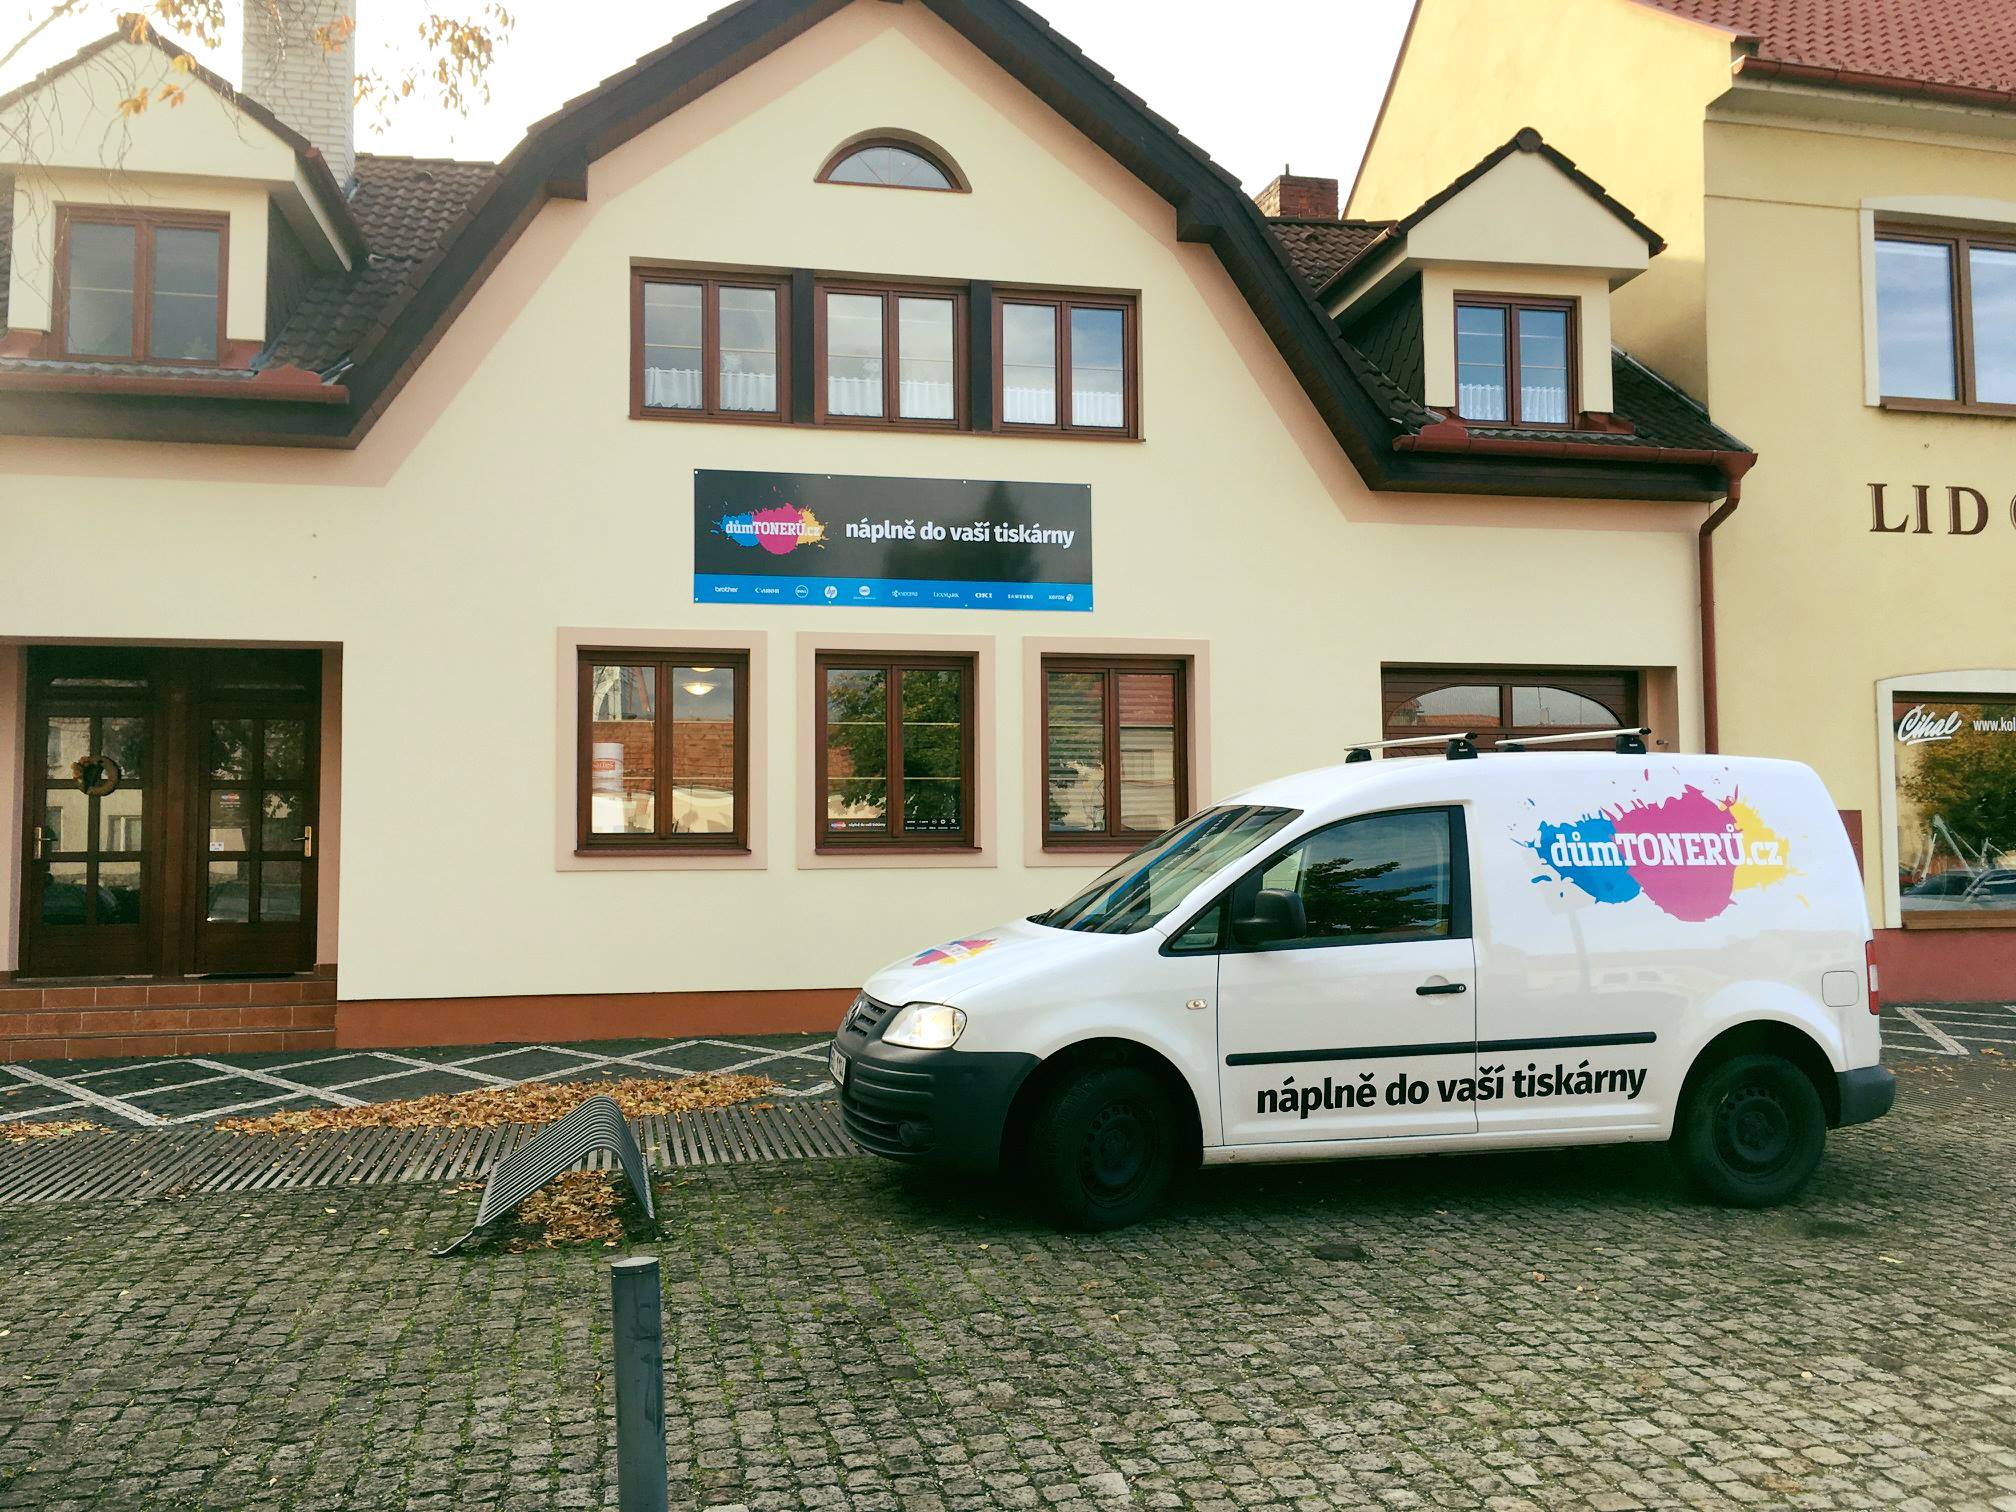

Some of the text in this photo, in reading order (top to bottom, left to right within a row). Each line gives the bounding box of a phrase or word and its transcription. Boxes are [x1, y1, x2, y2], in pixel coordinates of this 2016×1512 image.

[725, 519, 820, 537] důmTONERŮ.cz
[1867, 482, 2016, 536] LID
[845, 517, 1075, 549] náplně do vaší tiskárny
[825, 586, 837, 598] hp
[1550, 823, 1783, 867] důmTONERŮ.cz
[1256, 1059, 1648, 1119] náplně do vaší tiskárny
